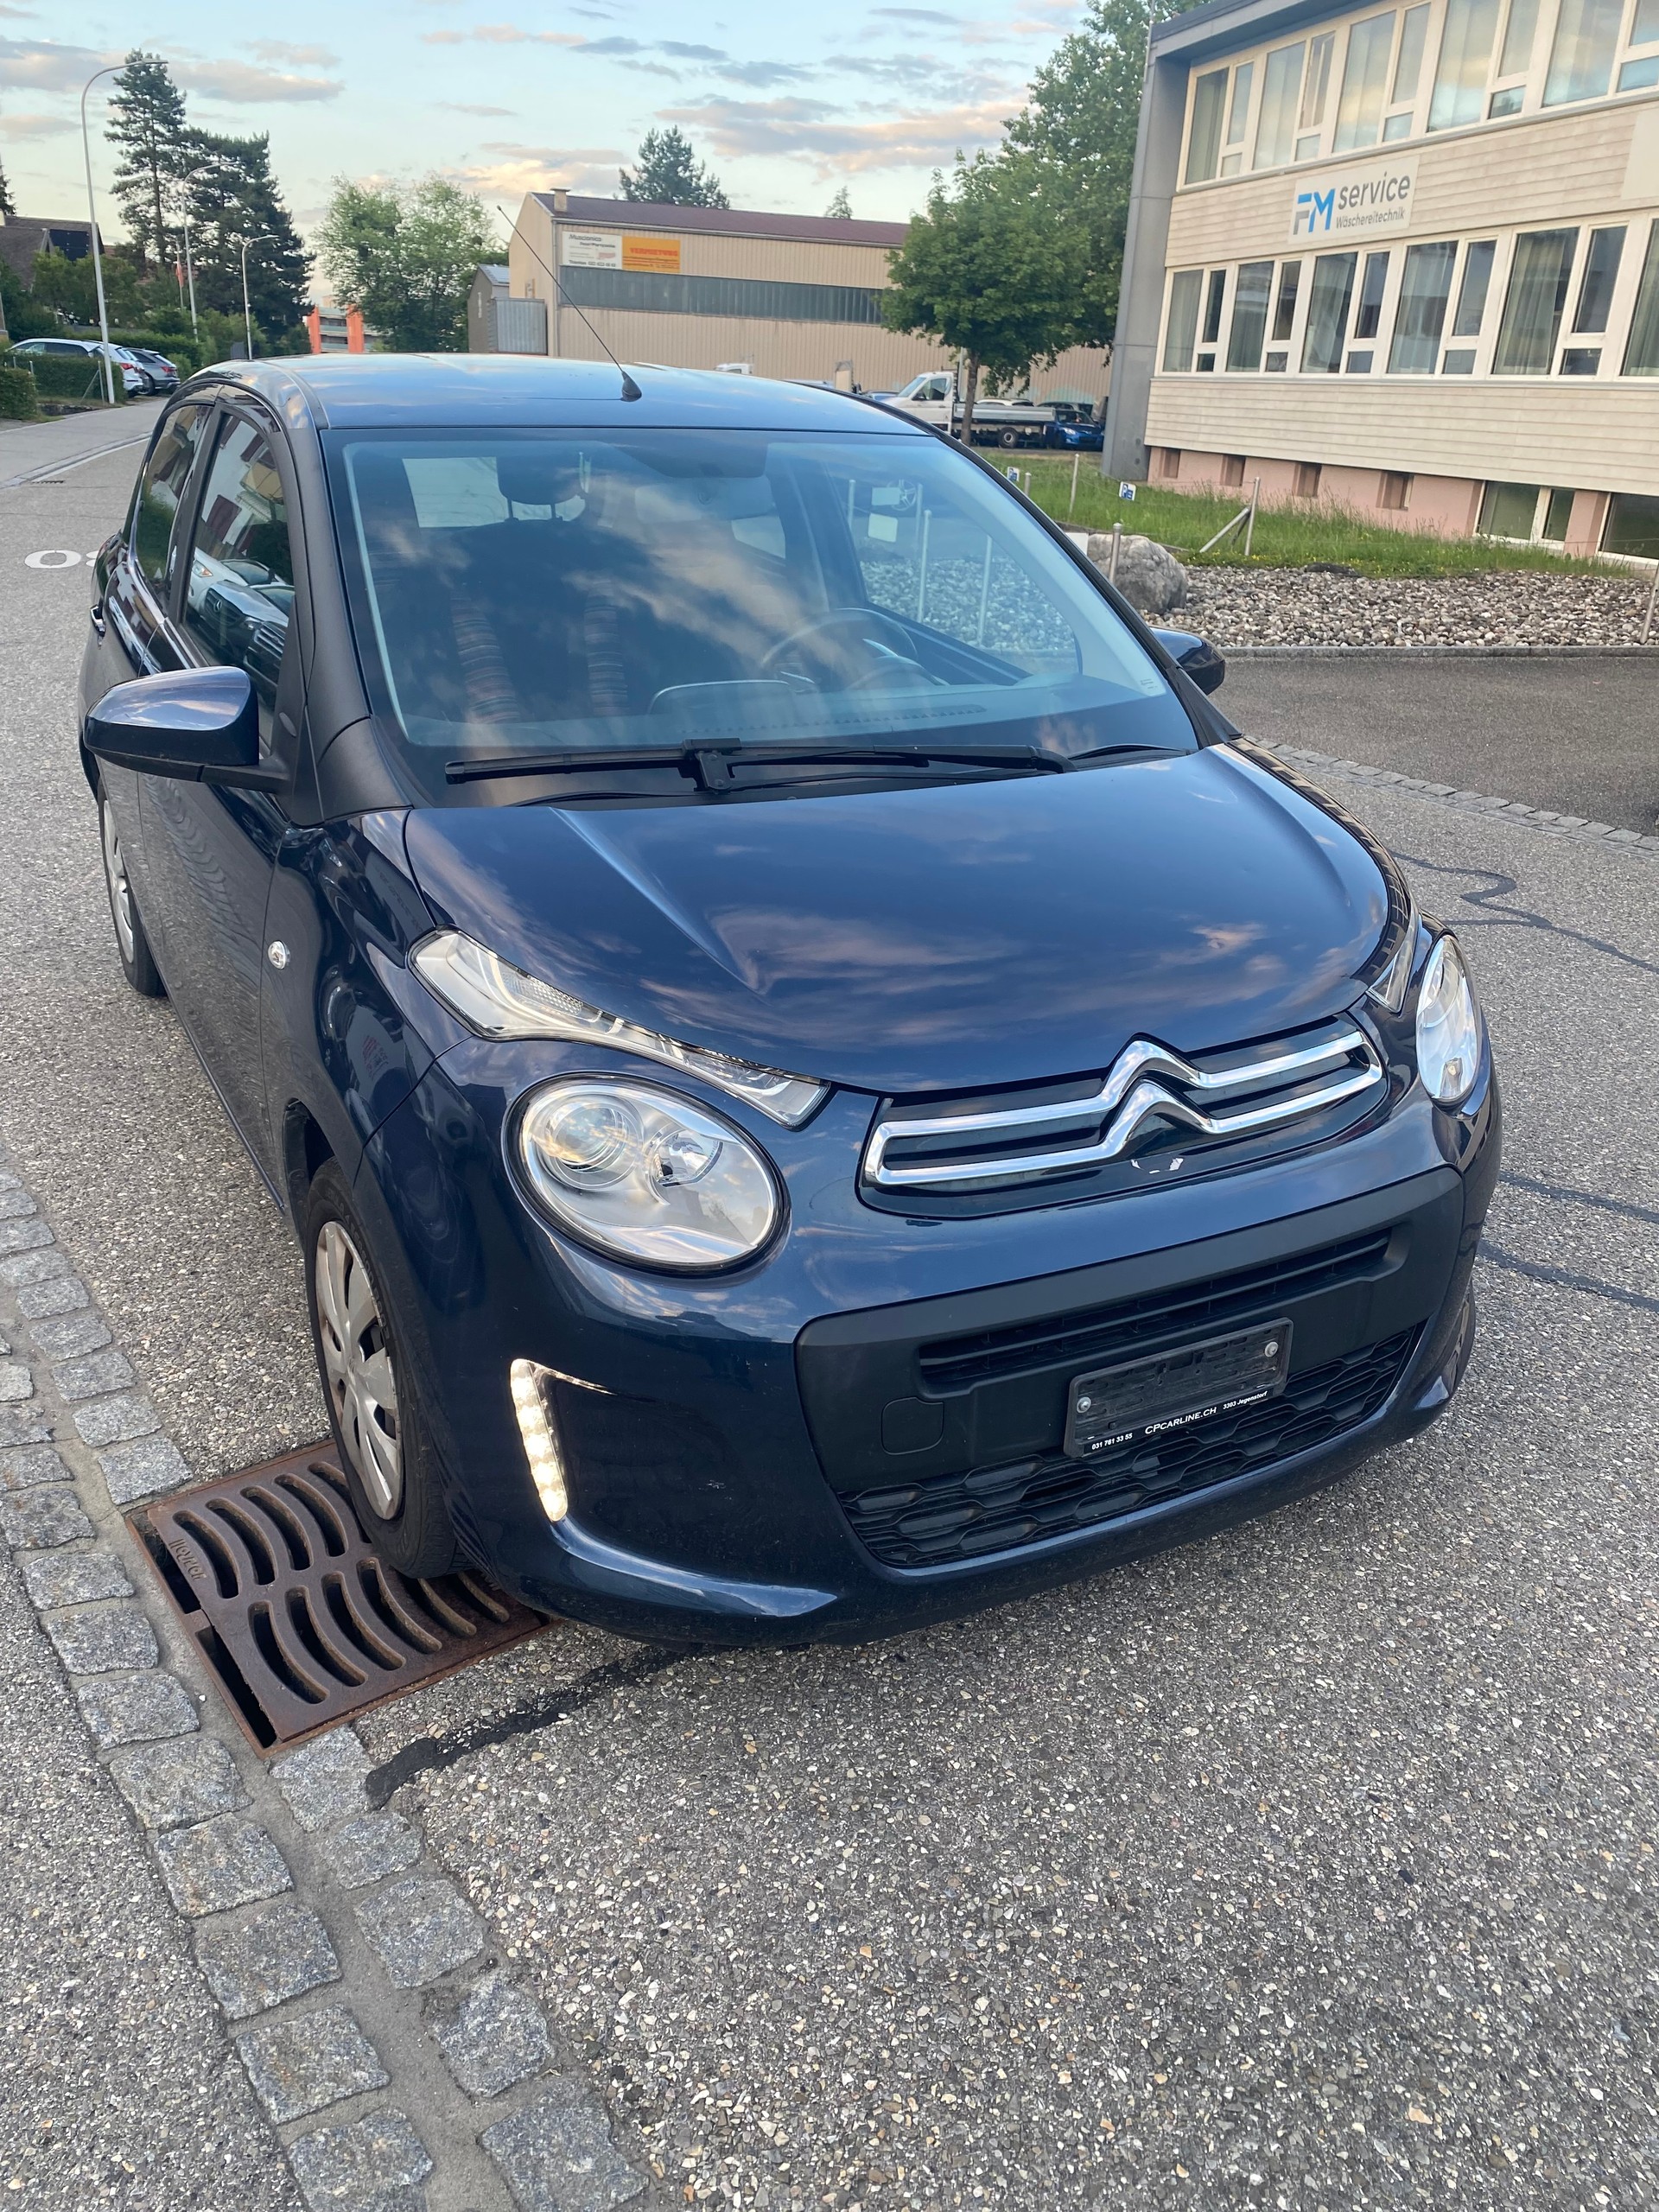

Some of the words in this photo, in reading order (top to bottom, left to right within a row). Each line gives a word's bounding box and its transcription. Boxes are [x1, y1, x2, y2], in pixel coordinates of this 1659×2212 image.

[1293, 188, 1336, 235] FM
[1338, 171, 1411, 210] service
[1336, 207, 1406, 229] Wäschereitechnik
[1091, 1441, 1103, 1450] 031
[1145, 1407, 1217, 1434] CPCARLINE.CH
[1236, 1390, 1268, 1405] Jegenstorf
